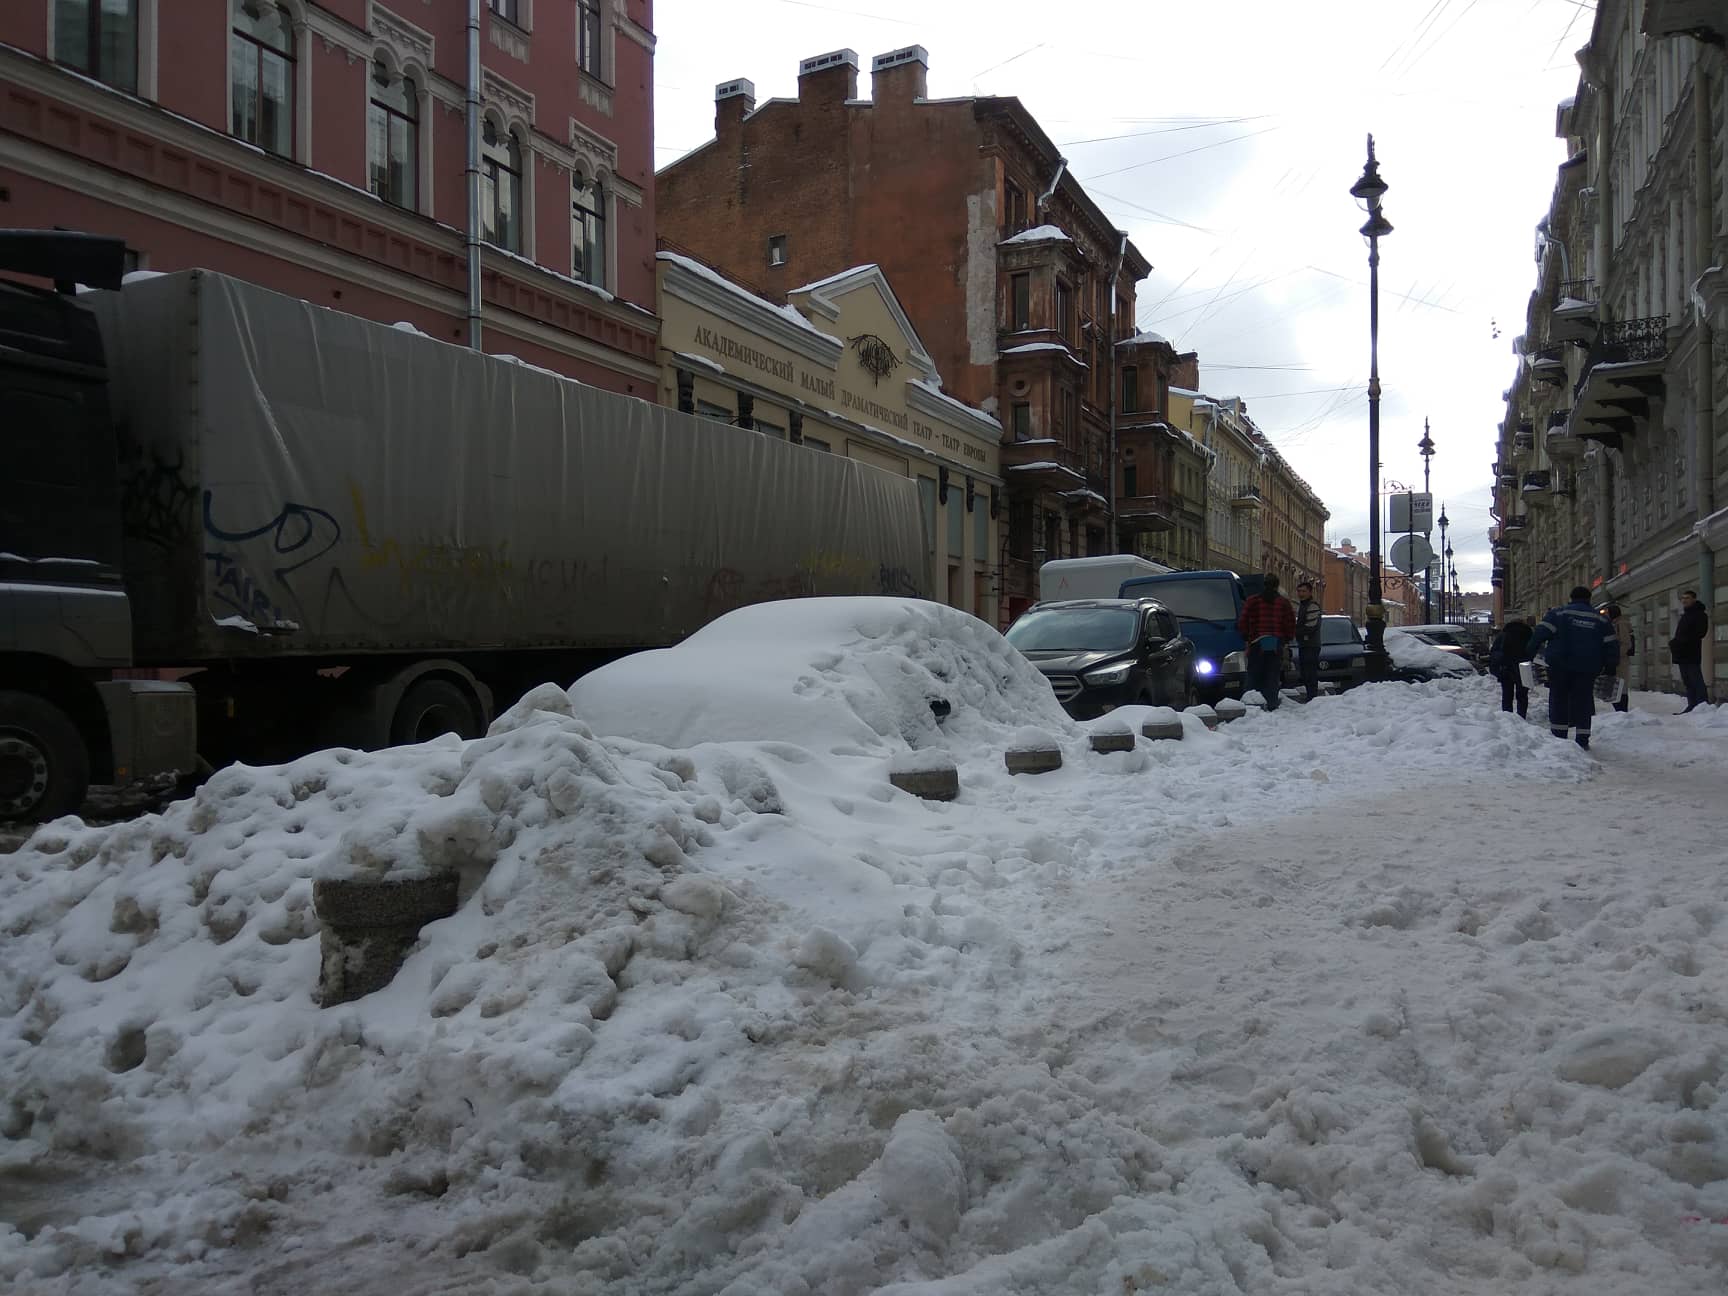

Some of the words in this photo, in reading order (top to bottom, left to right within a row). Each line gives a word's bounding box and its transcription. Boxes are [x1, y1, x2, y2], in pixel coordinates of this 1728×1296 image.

[694, 325, 794, 383] АКАДЕМИЧЕСКИЙ
[800, 371, 835, 400] МАЛЫЙ
[840, 390, 908, 431] ДРАМАТИЧЕСКИЙ
[913, 421, 932, 441] ТЕАТР
[942, 434, 961, 453] ТЕАТР
[963, 443, 986, 463] ЕВРОПЫ
